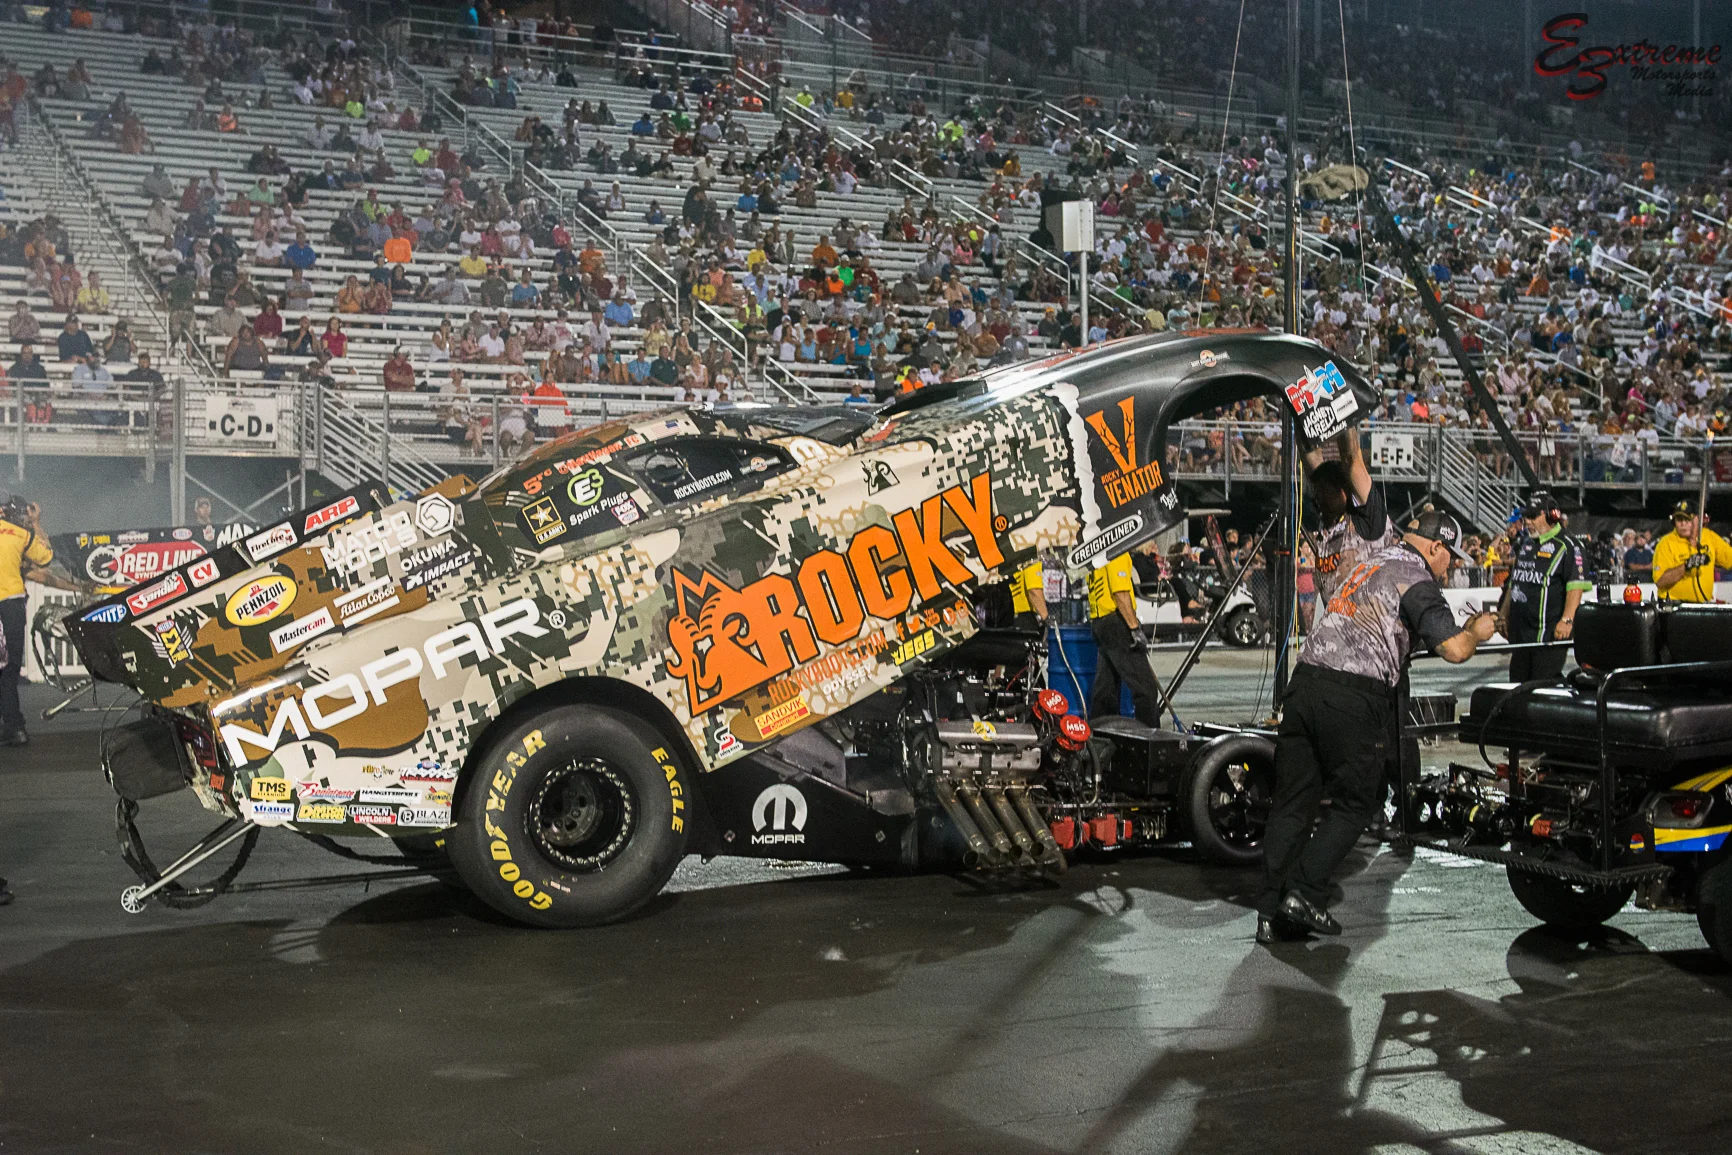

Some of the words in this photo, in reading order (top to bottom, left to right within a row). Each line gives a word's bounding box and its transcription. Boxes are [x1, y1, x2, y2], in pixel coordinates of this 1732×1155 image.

[673, 470, 733, 500] ROCKYBOOTS.COM
[1101, 468, 1121, 485] ROCKY
[1103, 459, 1164, 509] VENATOR
[305, 496, 356, 532] ARP
[569, 504, 600, 526] Spark
[600, 491, 629, 511] Plugs
[320, 509, 412, 570] MATCO
[331, 525, 418, 578] TOOLS
[400, 538, 458, 572] OKUMA
[1074, 519, 1136, 565] FREIGHTLINER
[122, 551, 159, 573] RED
[193, 563, 213, 580] CV
[235, 581, 287, 620] PENNZOIL
[339, 599, 367, 619] Atlas
[367, 586, 396, 606] Copco
[278, 615, 327, 645] Mastercam
[891, 629, 935, 666] JEGS
[219, 598, 550, 768] MOPAR
[768, 630, 889, 705] ROCKYBOOTS.COM
[822, 662, 872, 696] ODYSSEY
[757, 697, 804, 727] SANDVIK
[257, 782, 287, 793] TMS
[651, 747, 685, 834] EAGLE
[351, 807, 389, 816] LINCOLN
[359, 815, 392, 823] WELDERS
[751, 834, 806, 845] MOPAR
